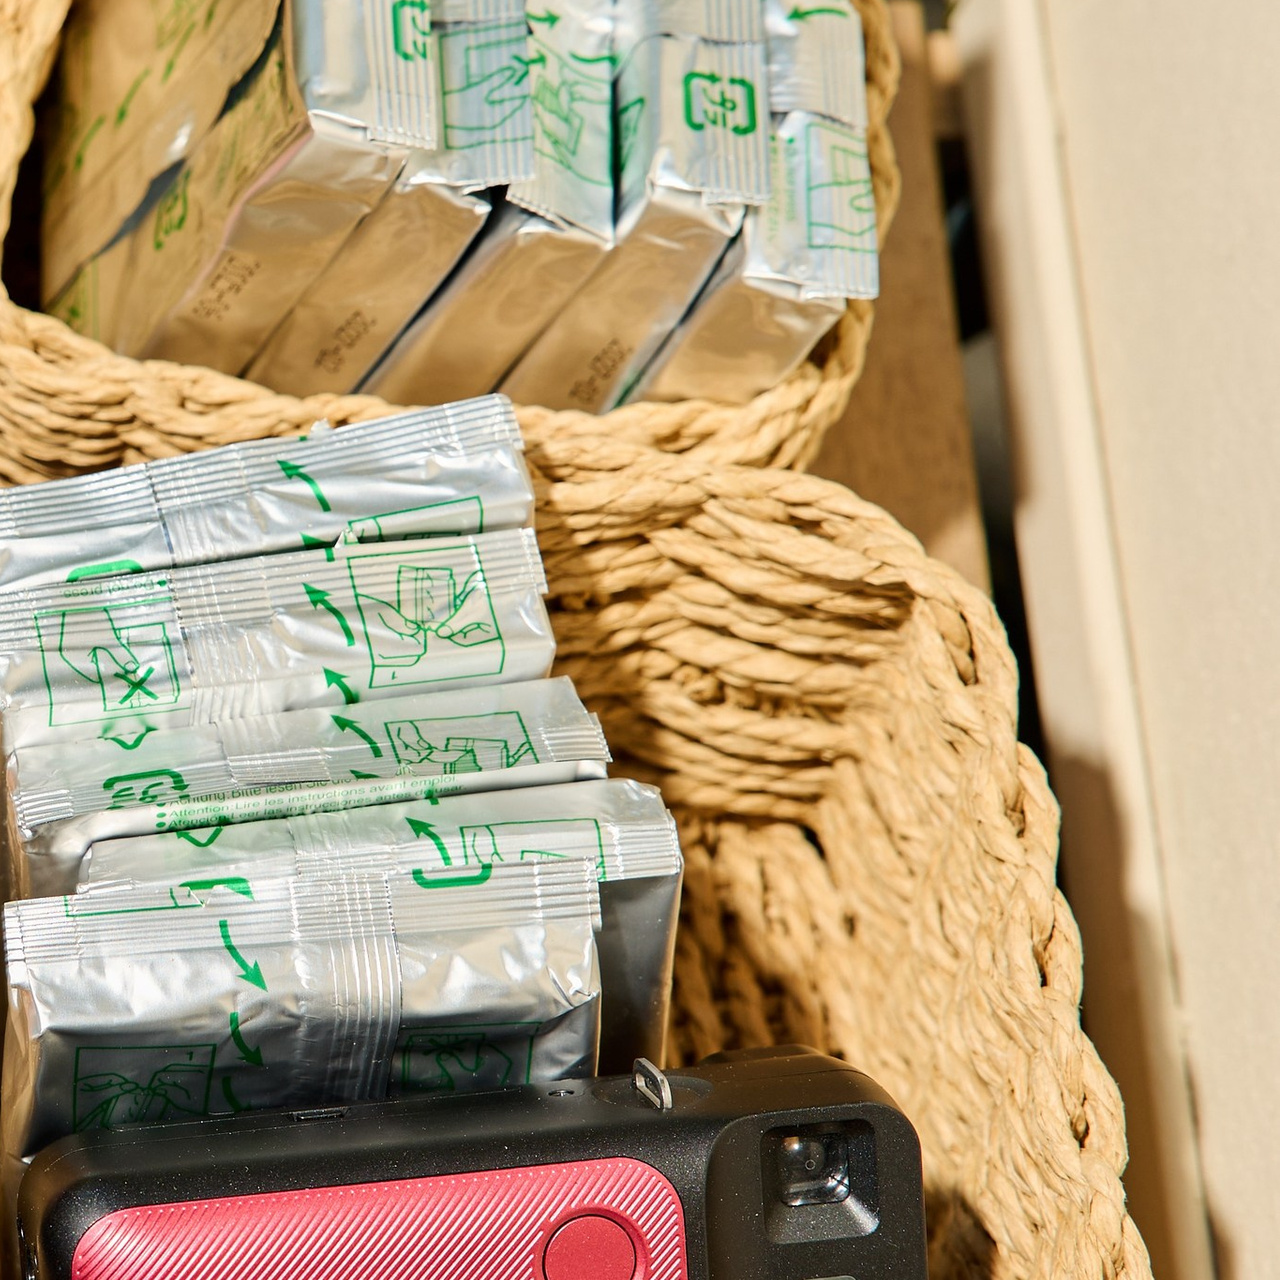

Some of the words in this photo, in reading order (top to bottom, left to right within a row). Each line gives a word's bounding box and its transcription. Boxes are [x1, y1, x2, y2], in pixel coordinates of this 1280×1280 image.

[264, 797, 284, 806] les
[288, 787, 366, 803] instructions
[369, 780, 407, 793] avant
[375, 790, 411, 801] antes
